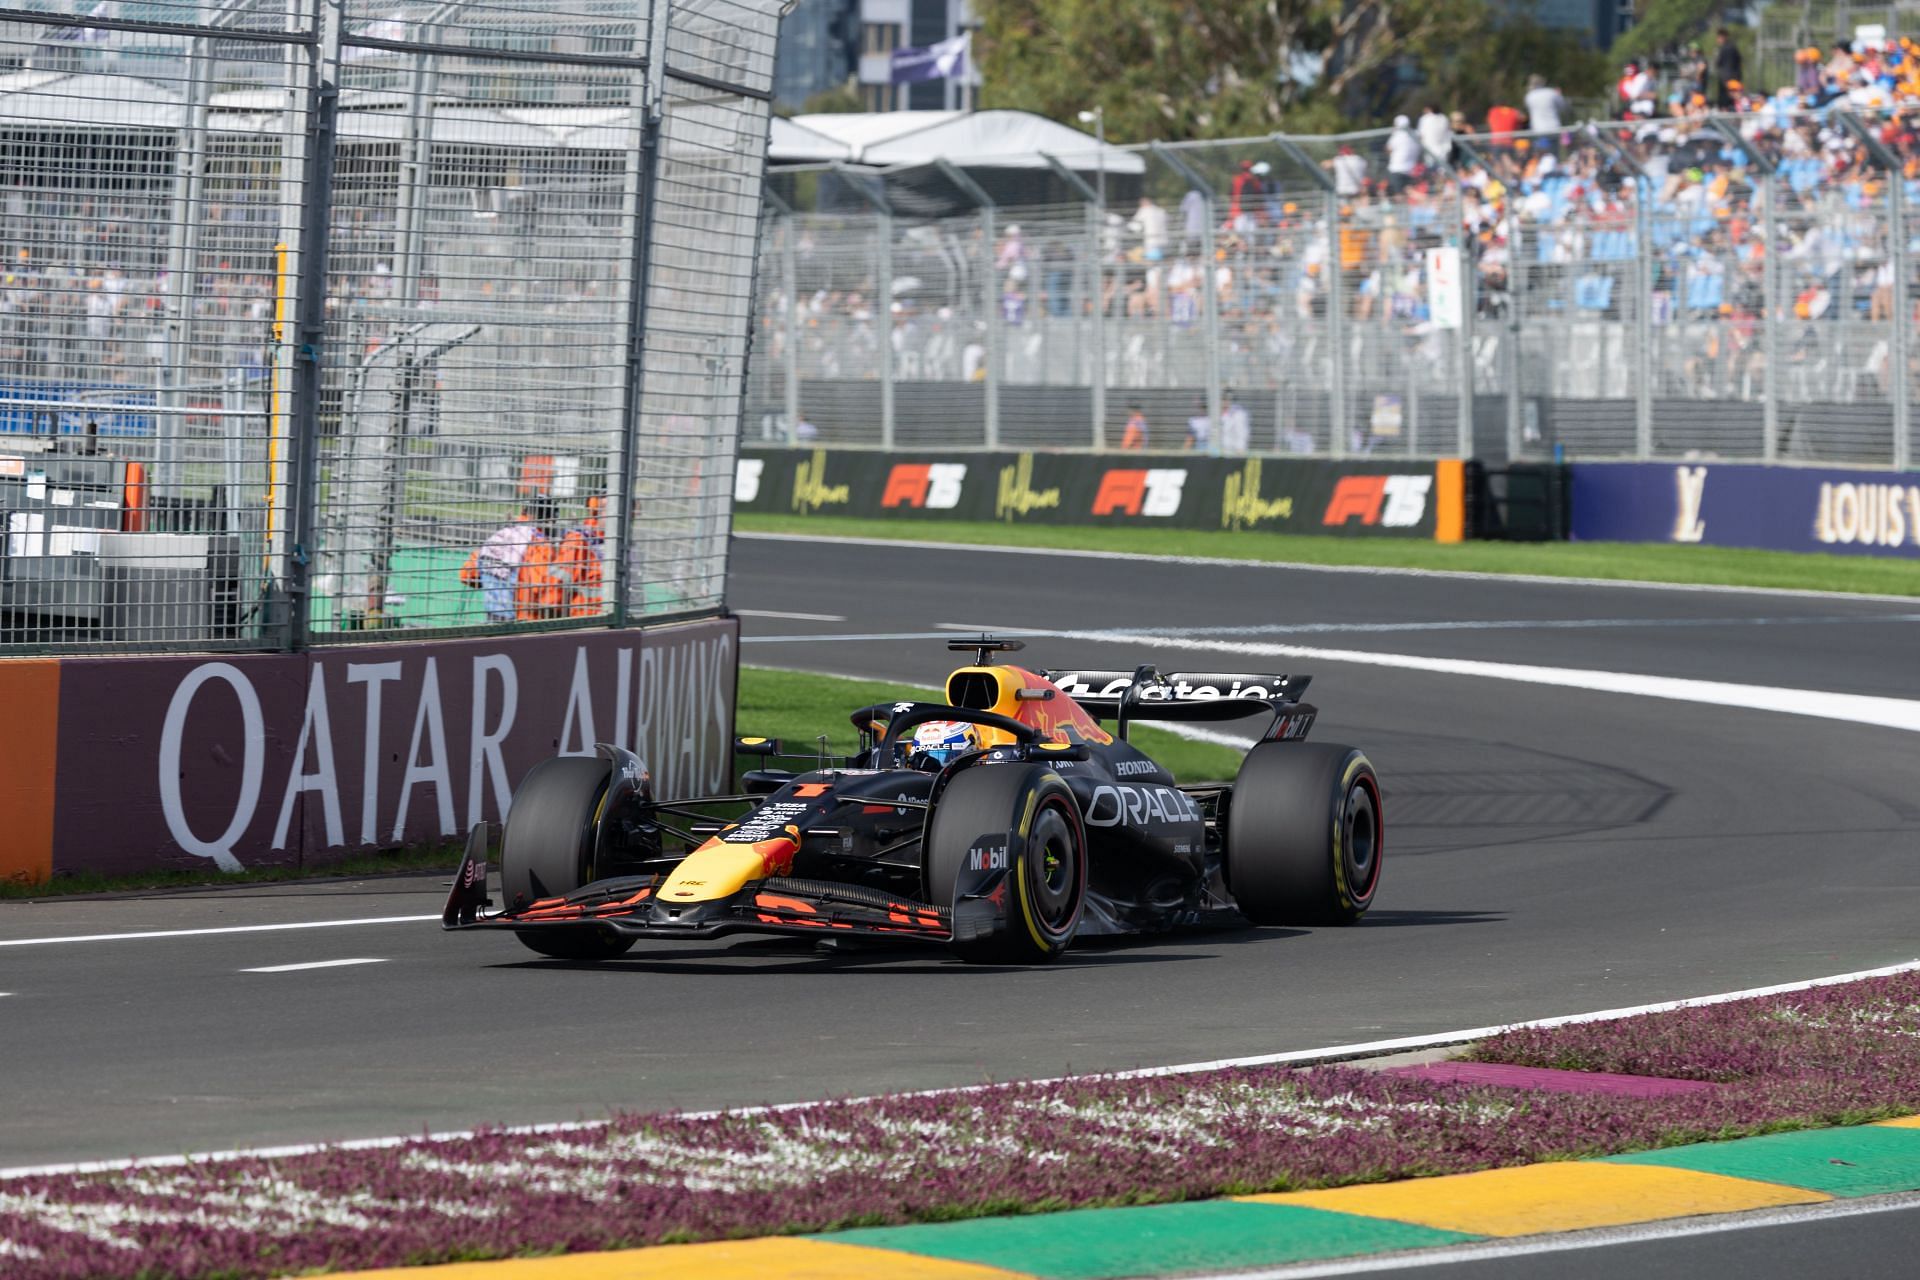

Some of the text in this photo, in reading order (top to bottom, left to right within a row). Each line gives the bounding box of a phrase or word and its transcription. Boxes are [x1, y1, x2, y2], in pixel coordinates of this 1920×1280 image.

[1818, 482, 1905, 548] LOUIS
[158, 633, 730, 873] QATAR AIRWAYS
[915, 743, 951, 753] ORACLE
[1116, 760, 1158, 776] HONDA
[794, 783, 833, 797] 1
[1085, 785, 1199, 827] ORACLE
[970, 846, 1007, 870] Mobil
